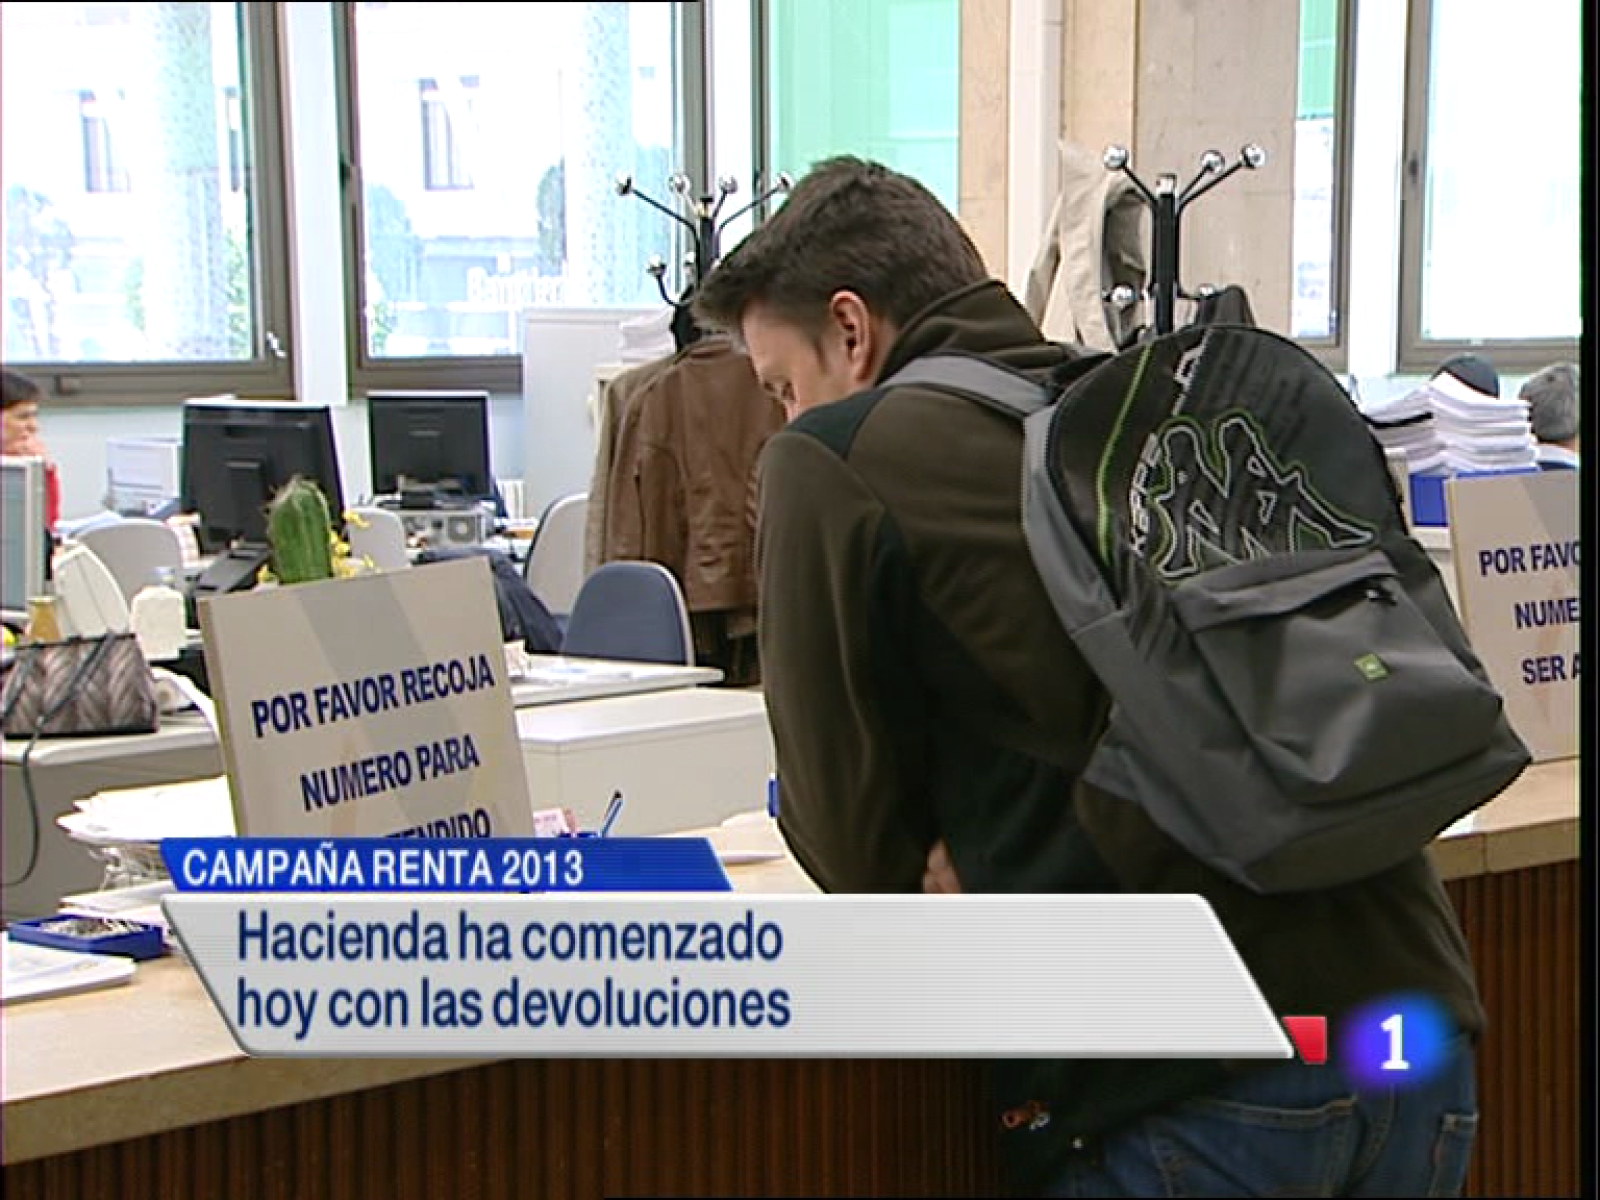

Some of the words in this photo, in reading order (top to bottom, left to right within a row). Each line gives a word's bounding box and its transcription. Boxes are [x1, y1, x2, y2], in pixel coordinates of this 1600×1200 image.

[1479, 547, 1527, 577] POR
[1514, 598, 1581, 629] NUME
[1521, 654, 1567, 684] SER
[251, 692, 311, 738] POR
[314, 673, 397, 725] FAVOR
[401, 653, 495, 705] RECOJA
[300, 750, 411, 812] NUMERO
[416, 734, 481, 781] PARA
